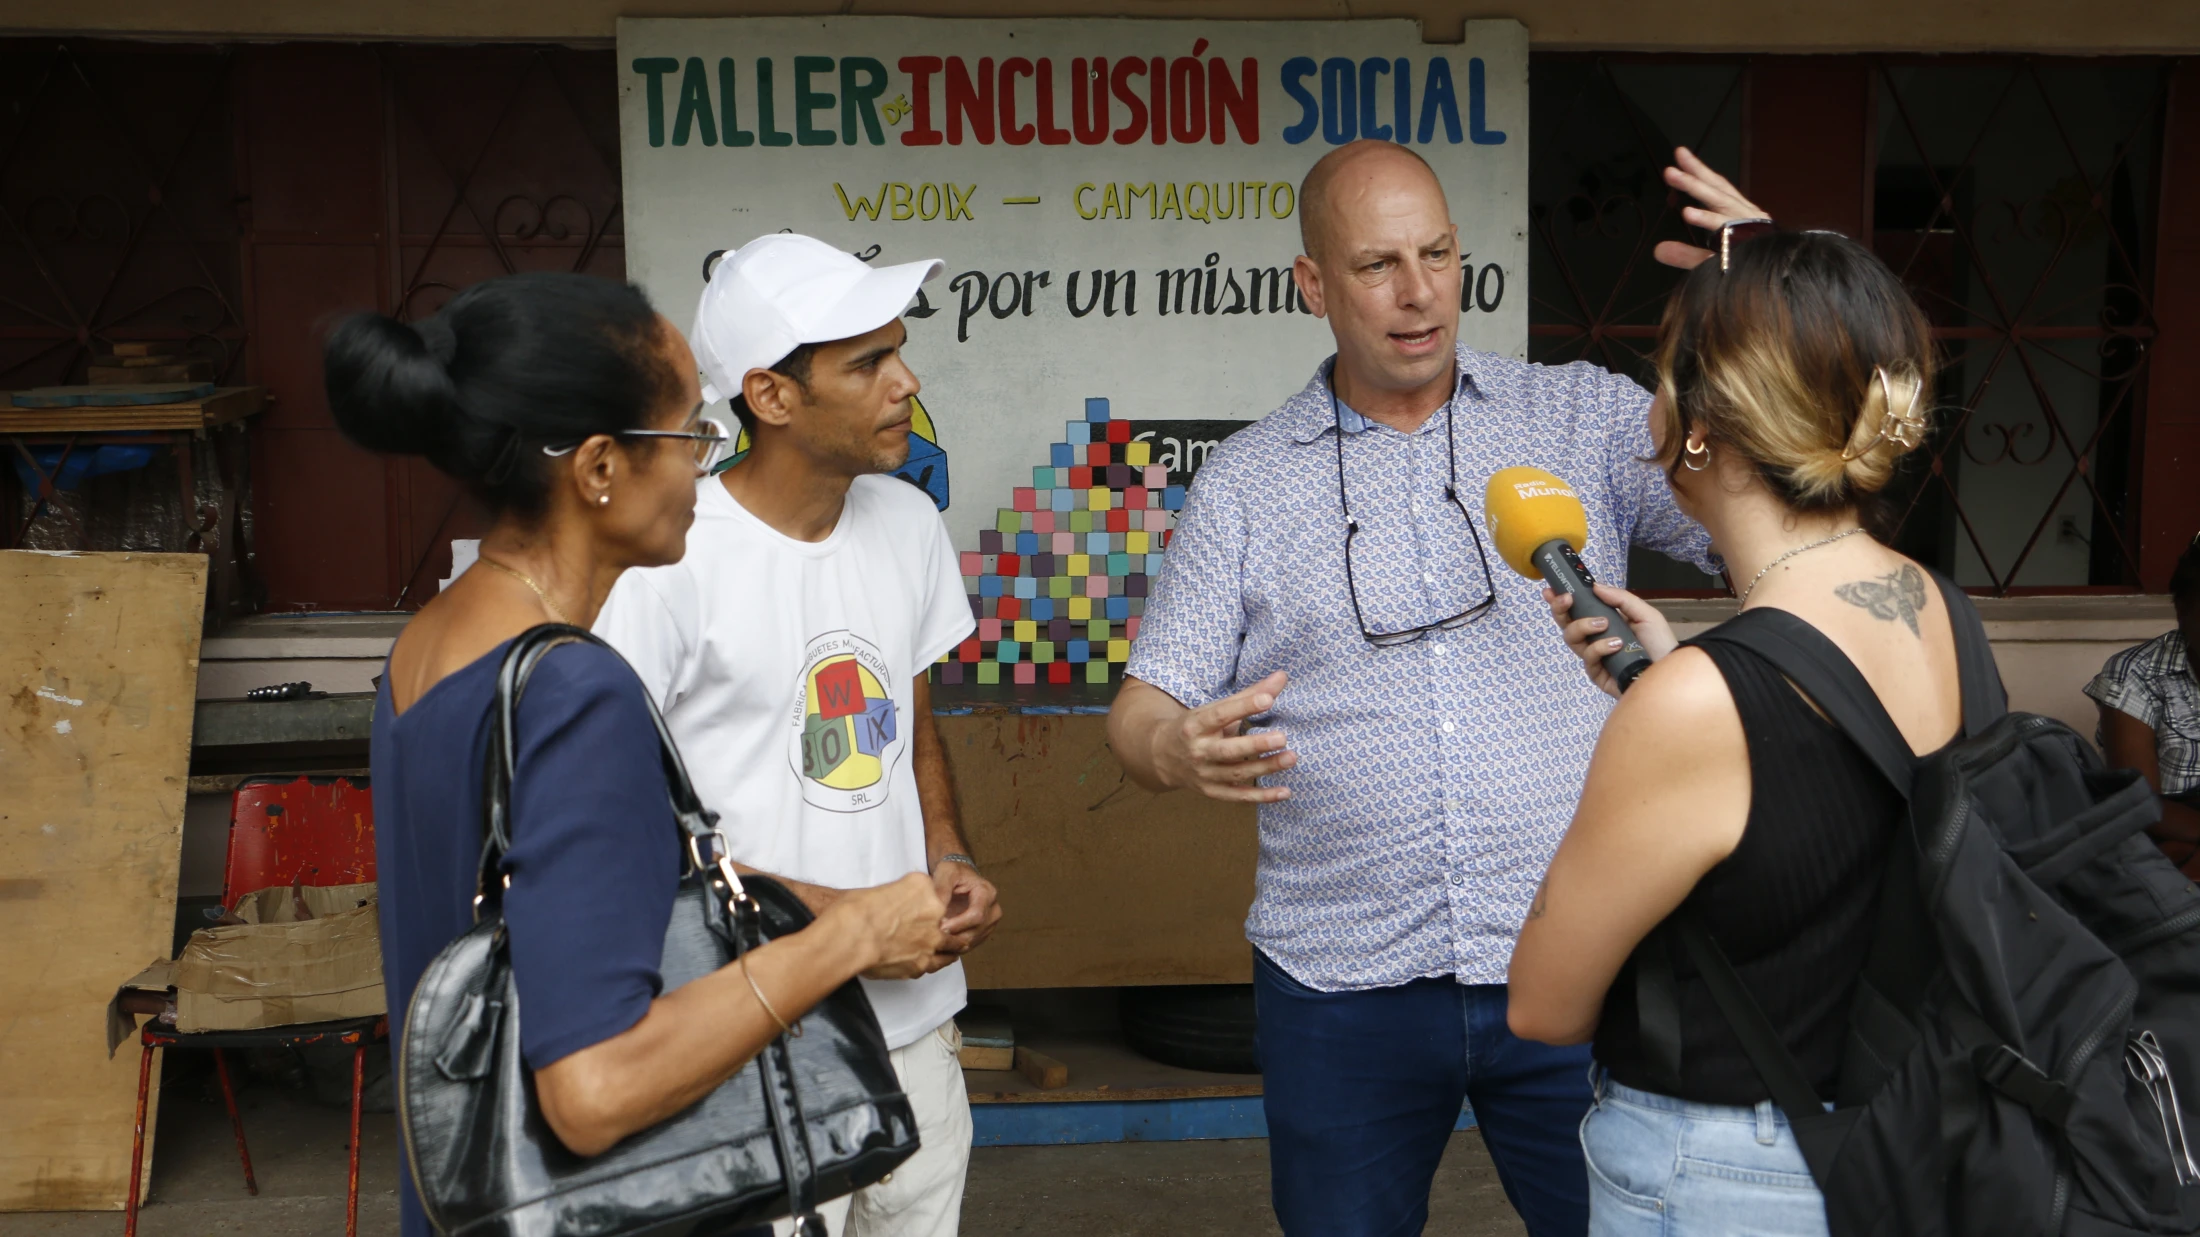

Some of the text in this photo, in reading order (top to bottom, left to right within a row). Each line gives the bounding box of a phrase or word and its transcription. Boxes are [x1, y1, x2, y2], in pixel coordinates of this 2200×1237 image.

[632, 38, 1506, 147] TALLER DE INCLUSIÓN SOCIAL
[833, 182, 977, 221] WBOIX
[1074, 181, 1294, 224] CAMAQUITO
[949, 270, 1052, 343] por
[1066, 269, 1139, 318] un
[1155, 252, 1321, 316] mism
[1131, 431, 1220, 473] Cam
[1513, 480, 1546, 490] Radio
[1549, 559, 1575, 595] YELLOWTEC
[805, 641, 839, 668] UGUETES
[842, 640, 889, 683] MFACTURAS
[823, 679, 851, 709] W
[851, 792, 872, 806] SRL
